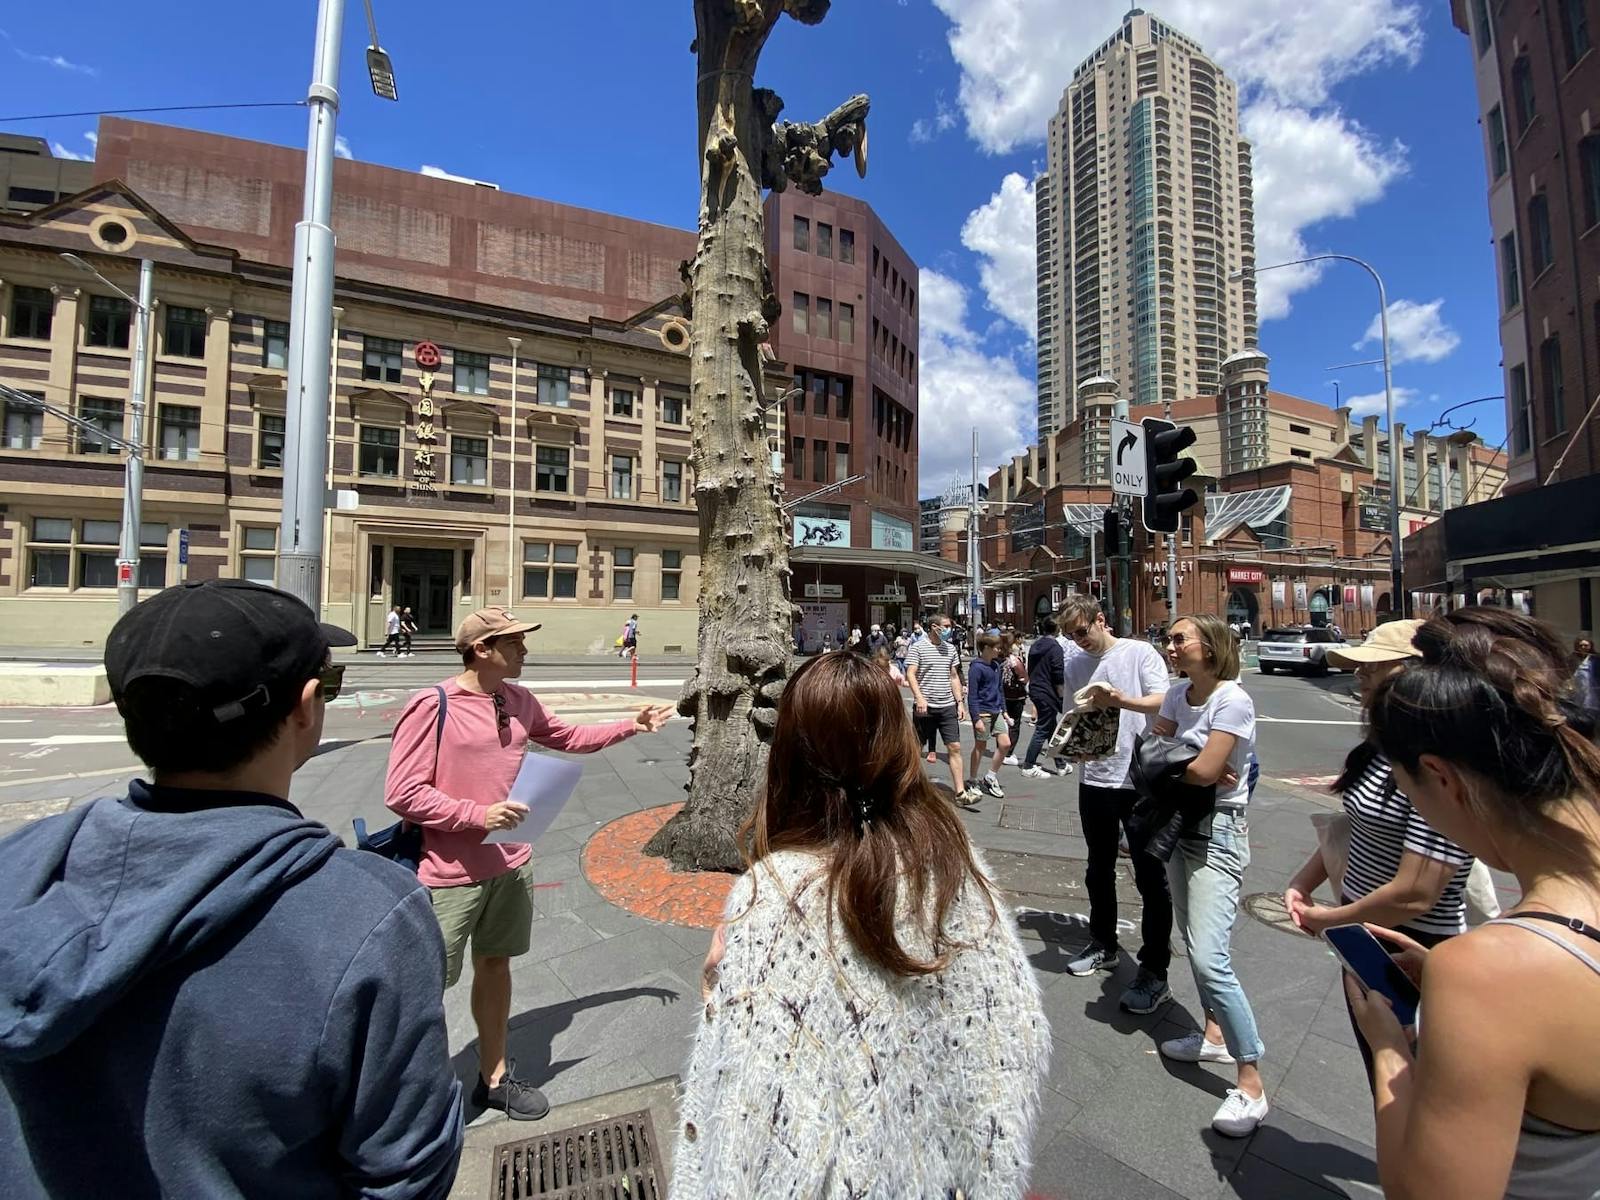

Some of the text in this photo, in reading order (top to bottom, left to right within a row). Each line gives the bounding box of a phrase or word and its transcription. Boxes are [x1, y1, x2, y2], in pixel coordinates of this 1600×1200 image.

[413, 468, 436, 477] BANK
[418, 476, 430, 484] OF
[1115, 472, 1143, 488] ONLY
[410, 482, 438, 491] CHINA
[1144, 561, 1194, 573] MARET
[1230, 571, 1262, 580] MARKET CITY
[1153, 575, 1185, 587] CIY
